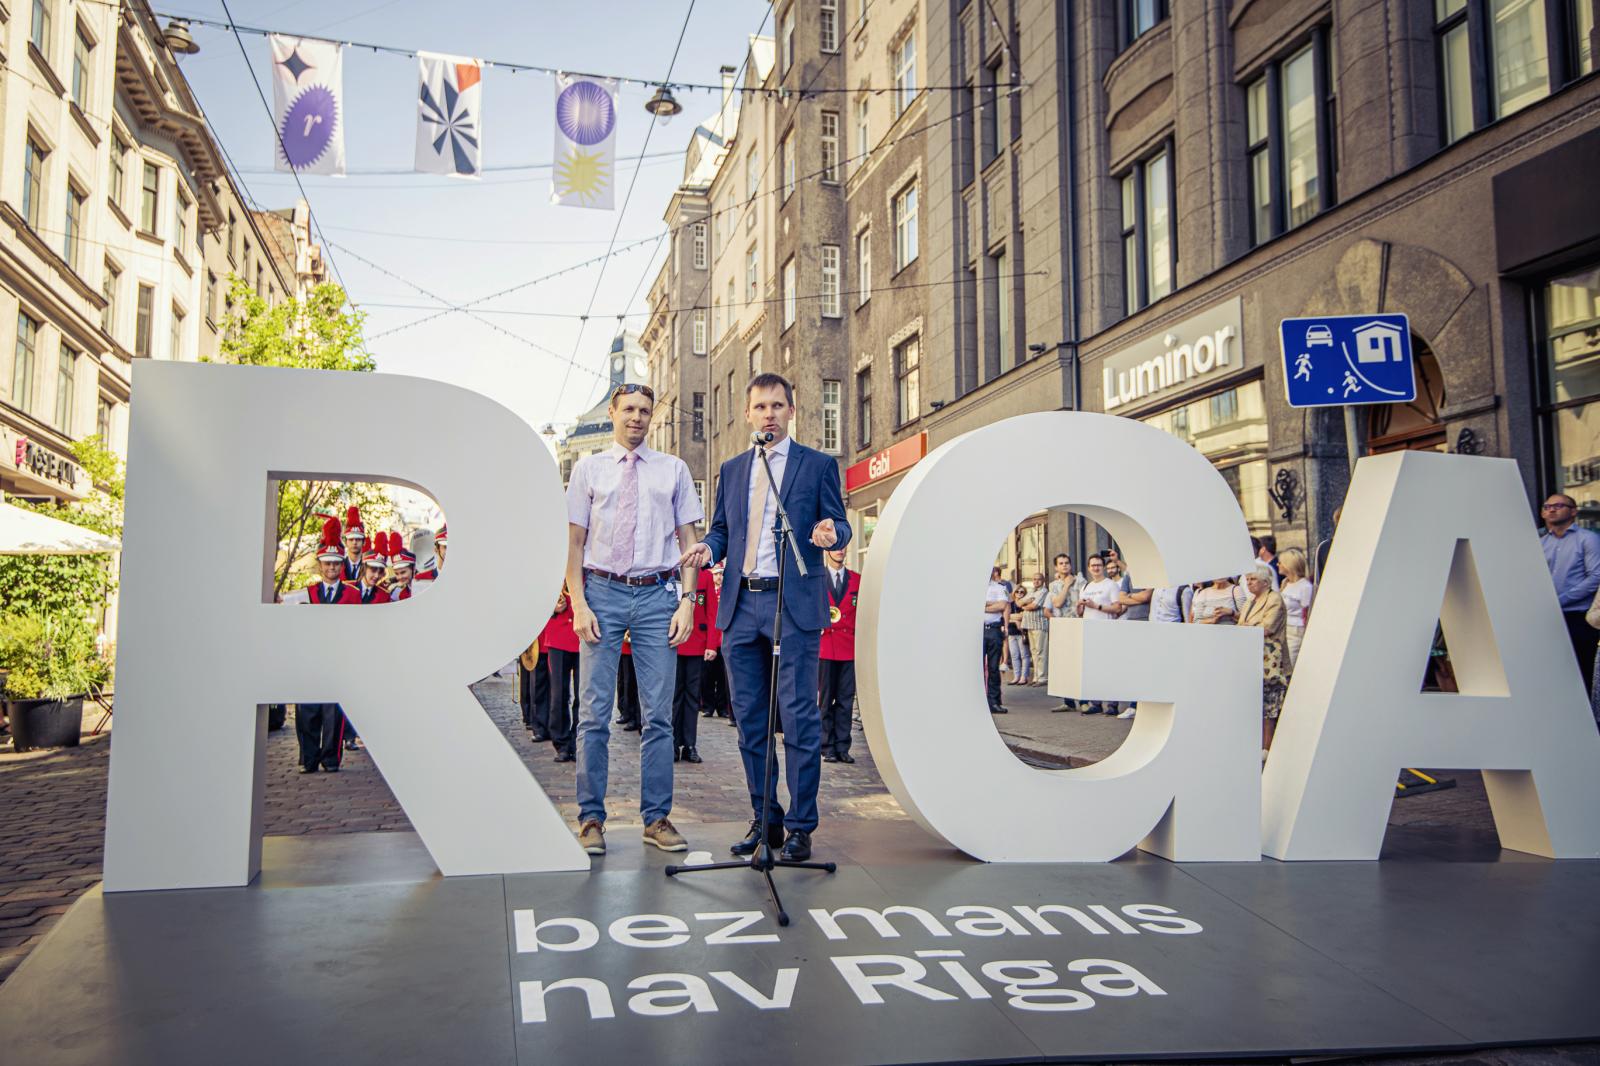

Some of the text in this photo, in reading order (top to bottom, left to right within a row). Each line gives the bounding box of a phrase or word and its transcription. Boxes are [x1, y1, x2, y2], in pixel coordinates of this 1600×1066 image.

[303, 113, 323, 137] r
[1103, 325, 1235, 410] Luminor
[868, 450, 891, 480] Gabi
[514, 909, 781, 954] bez
[520, 949, 1168, 1024] nav Rīga
